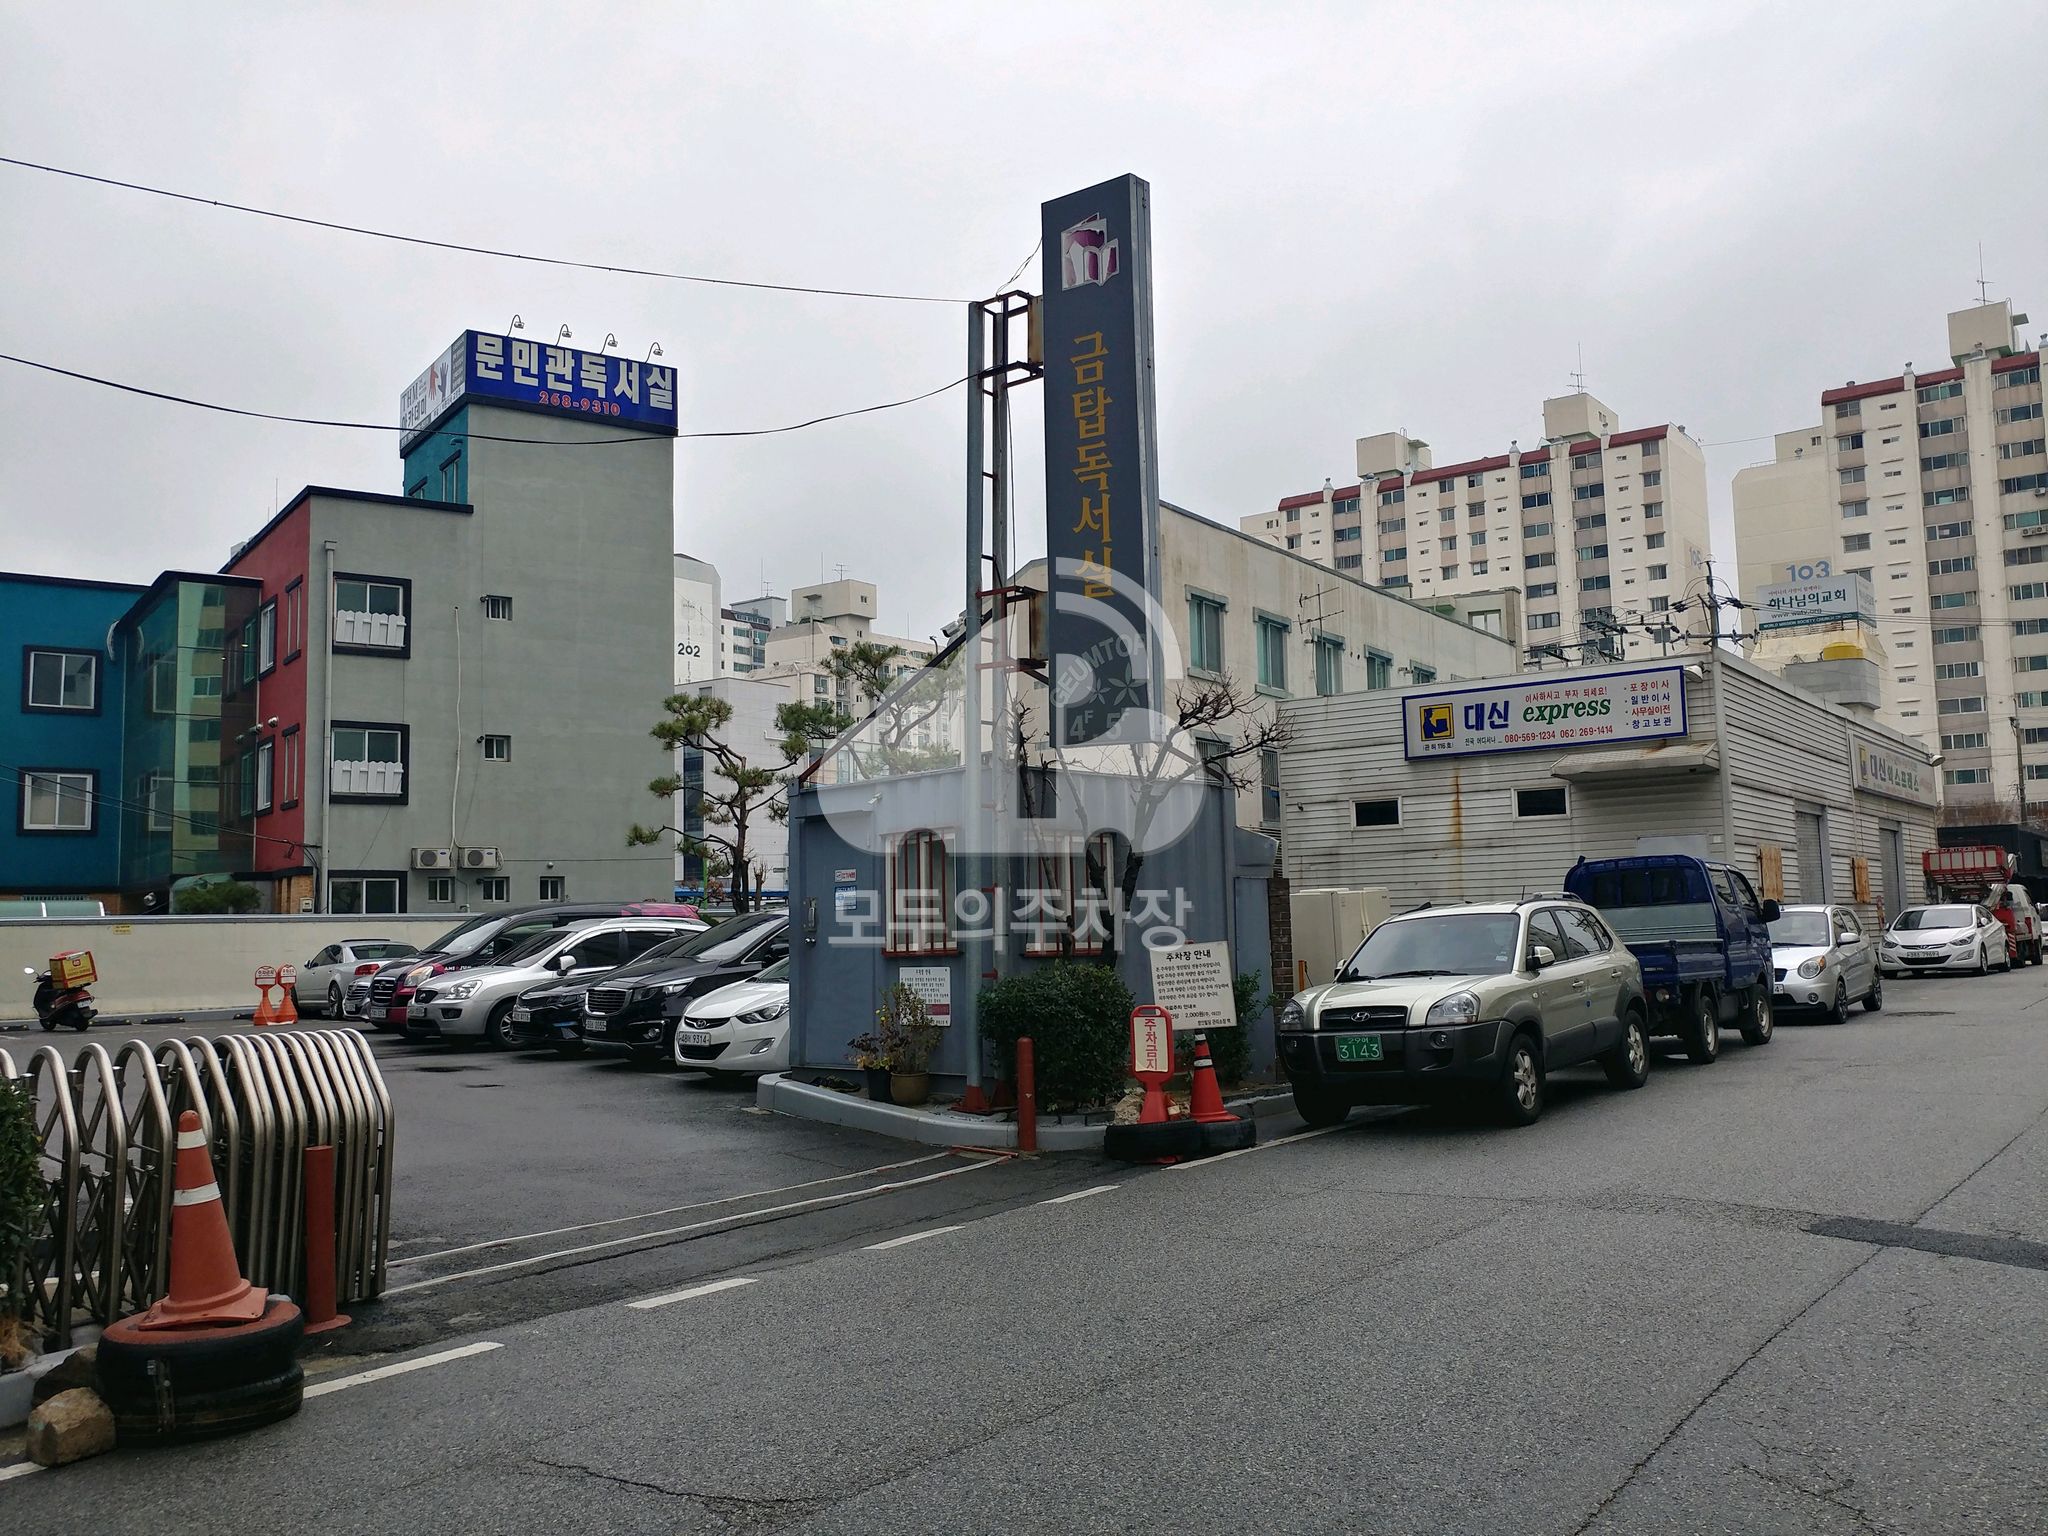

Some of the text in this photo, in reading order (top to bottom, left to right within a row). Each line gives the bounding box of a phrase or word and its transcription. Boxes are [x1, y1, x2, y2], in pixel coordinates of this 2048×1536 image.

[475, 334, 674, 410] 문민관독서실
[539, 391, 620, 416] 268-9310
[1069, 330, 1114, 598] 금탑독서실
[1786, 560, 1830, 582] 103
[1769, 588, 1846, 610] 하나님의교회
[678, 642, 700, 658] 202
[1526, 686, 1608, 704] 이사하시고 부자 되세요!
[1464, 699, 1610, 730] 대신 express
[1632, 704, 1670, 716] 사무실이전
[1504, 731, 1556, 744] 080-569-1234
[1580, 725, 1613, 737] 269-1414
[1166, 949, 1212, 962] 주차장 안내
[693, 1034, 706, 1044] 9314
[1144, 1018, 1158, 1070] 주차금지
[1340, 1044, 1380, 1058] 3143
